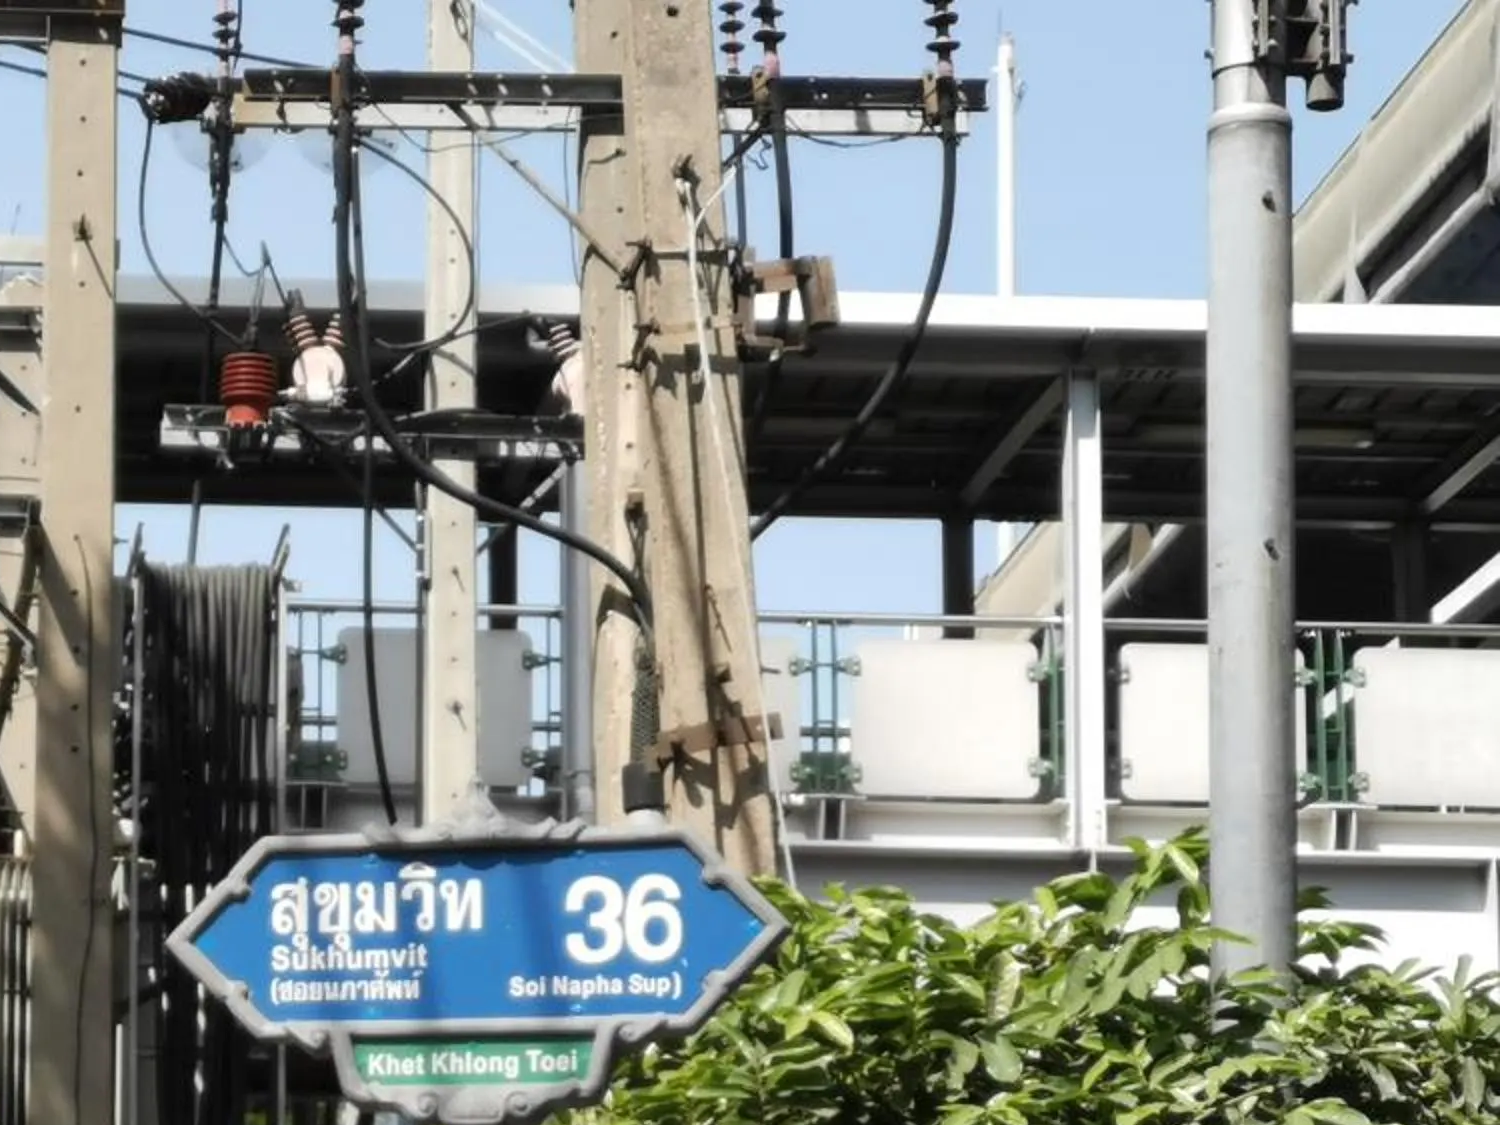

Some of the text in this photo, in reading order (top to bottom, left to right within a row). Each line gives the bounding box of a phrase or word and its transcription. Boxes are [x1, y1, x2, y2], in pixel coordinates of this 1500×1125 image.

[271, 862, 484, 950] สุขุมวิท
[564, 873, 684, 964] 36
[271, 943, 428, 971] Sukhumvit
[509, 971, 682, 999] Soi Napha Sup)
[367, 1049, 578, 1079] Khet Khlong Toei
